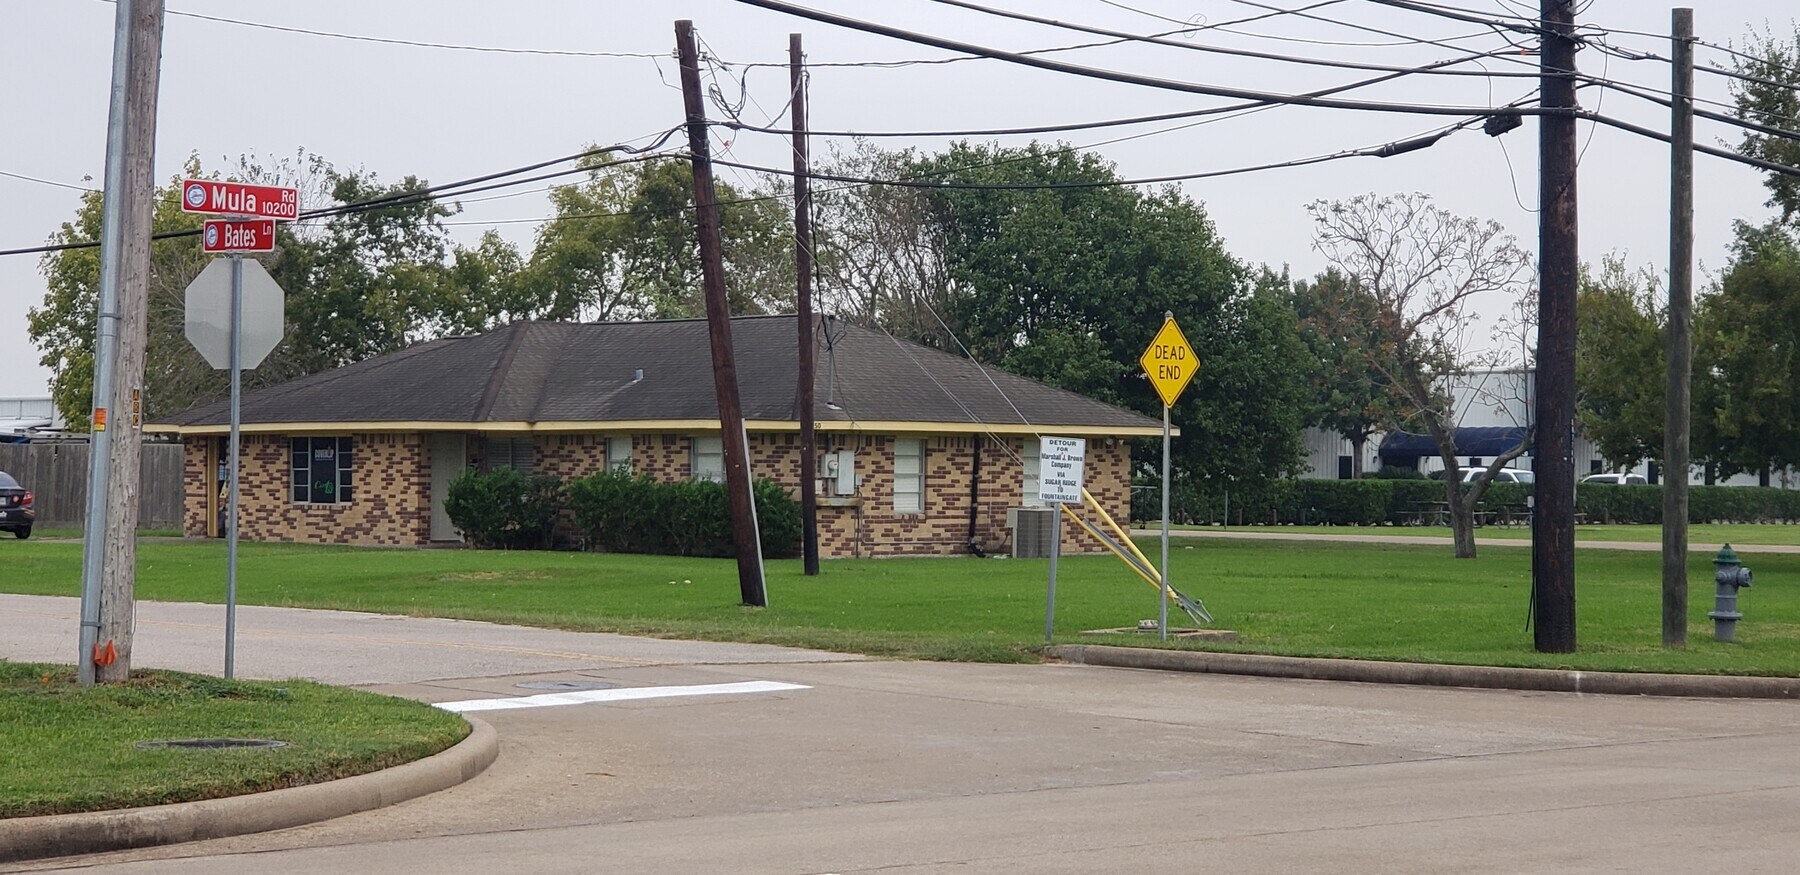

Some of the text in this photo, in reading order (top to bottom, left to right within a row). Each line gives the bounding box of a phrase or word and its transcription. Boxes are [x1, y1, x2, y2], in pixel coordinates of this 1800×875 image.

[212, 185, 295, 212] Mula Rd
[262, 201, 295, 215] 10200
[224, 222, 272, 247] Bates Ln
[1155, 345, 1186, 360] DEAD
[1159, 365, 1181, 380] END
[1051, 461, 1072, 469] Company
